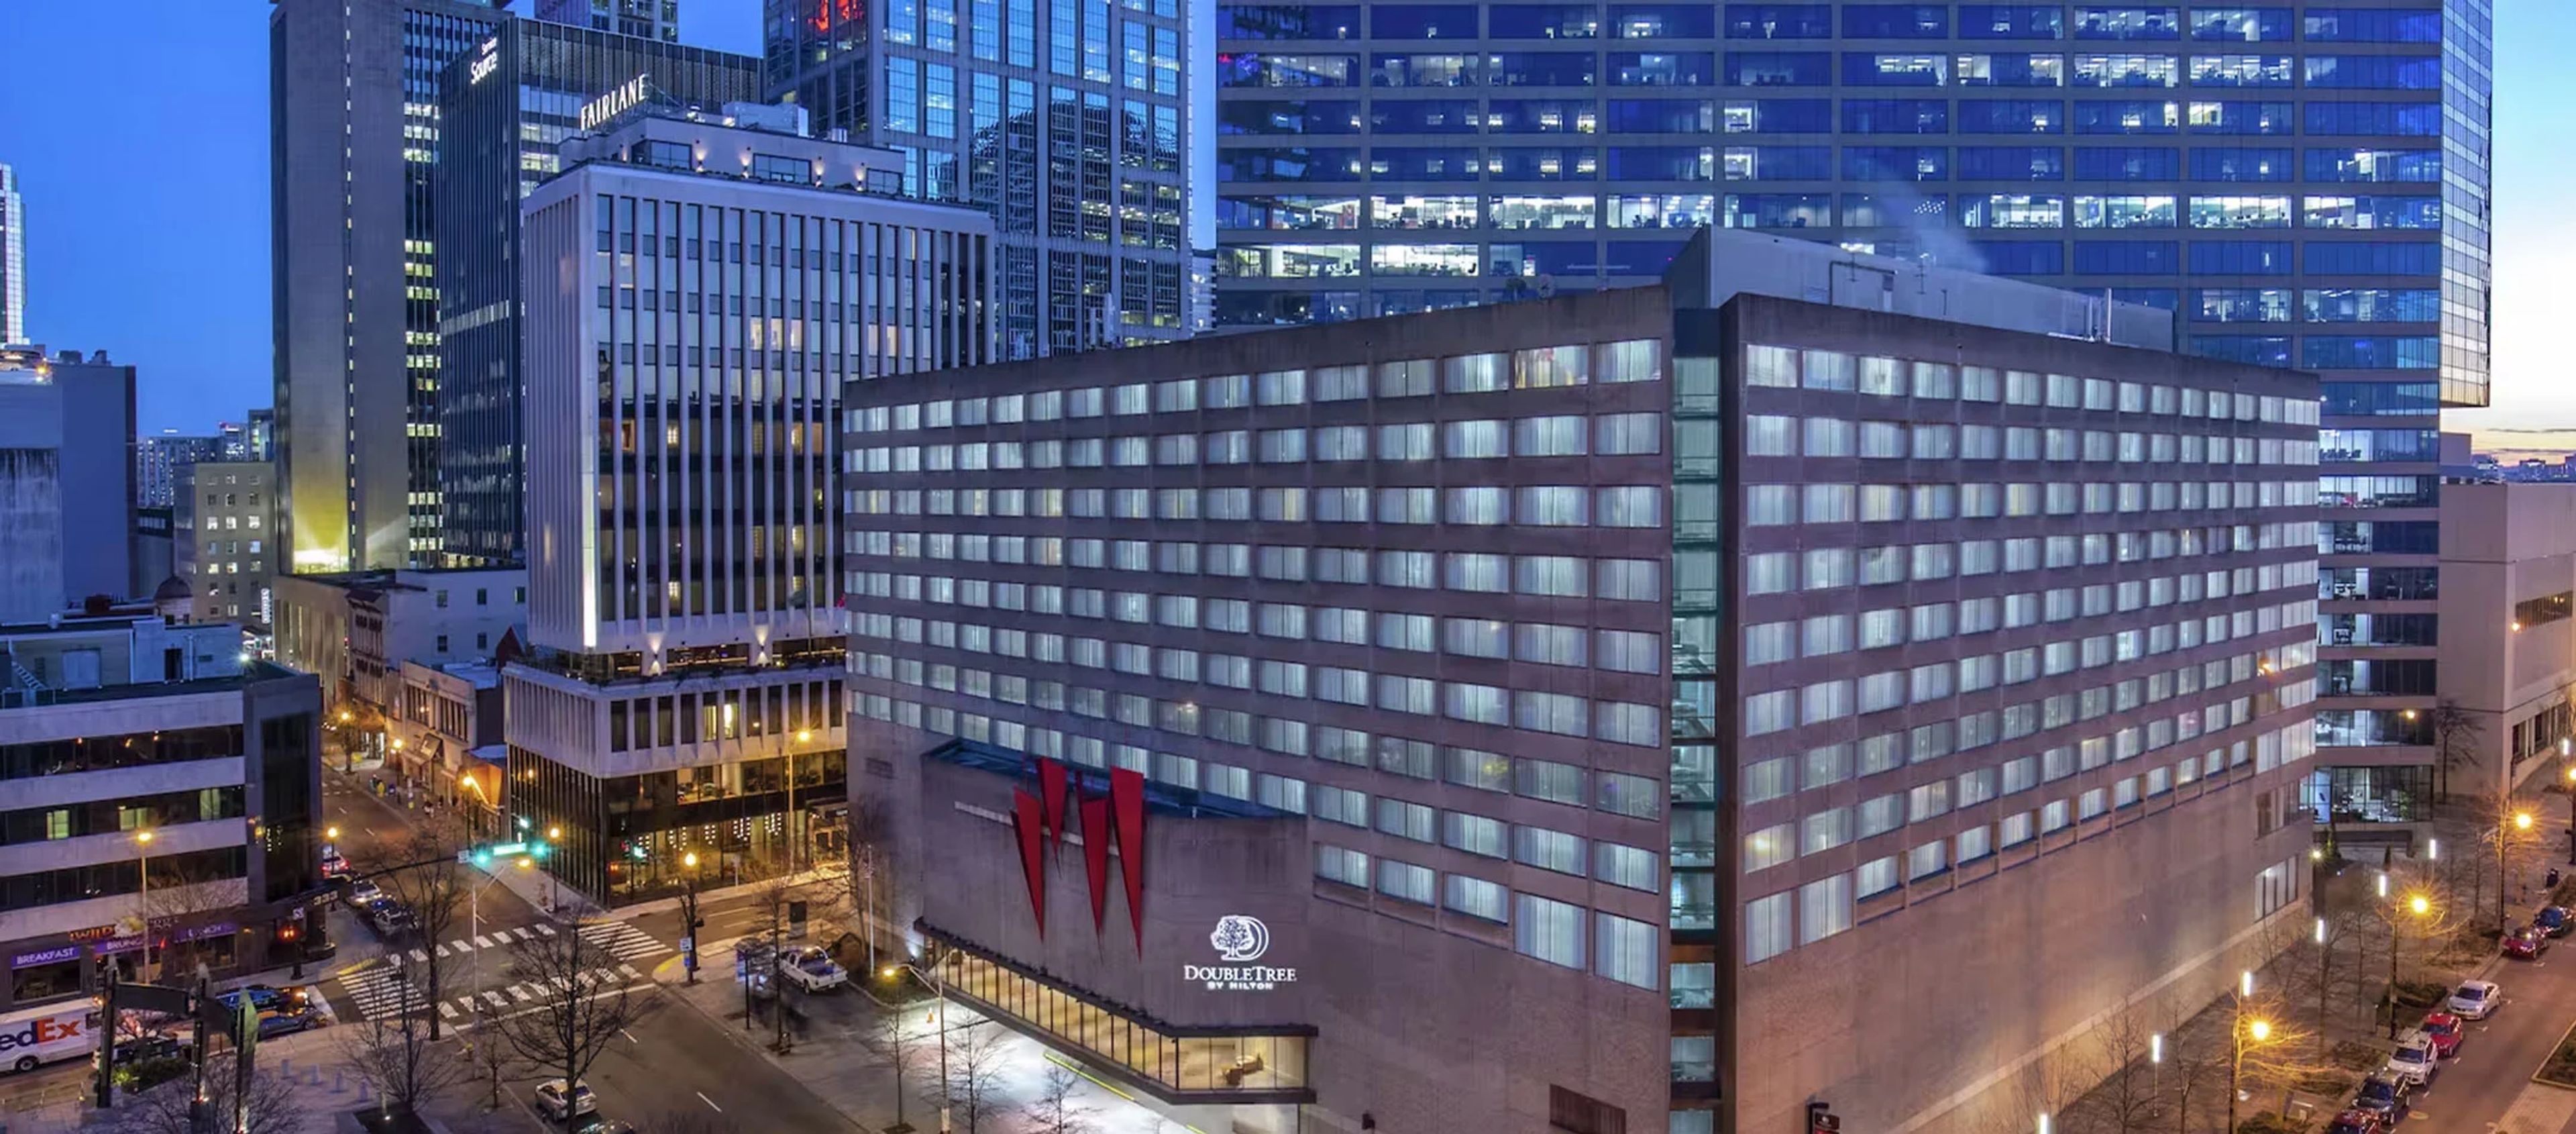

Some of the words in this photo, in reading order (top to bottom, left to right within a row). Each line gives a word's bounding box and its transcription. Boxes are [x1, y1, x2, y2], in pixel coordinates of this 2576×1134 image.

[470, 51, 497, 85] Source
[580, 73, 649, 132] FAIRLANE
[107, 937, 144, 950] BRUNC
[17, 947, 75, 965] BREAKFAST
[1183, 964, 1297, 982] DOUBLETREE
[1207, 982, 1224, 990] BY
[1229, 982, 1274, 990] HILTON
[0, 1017, 80, 1051] edEx
